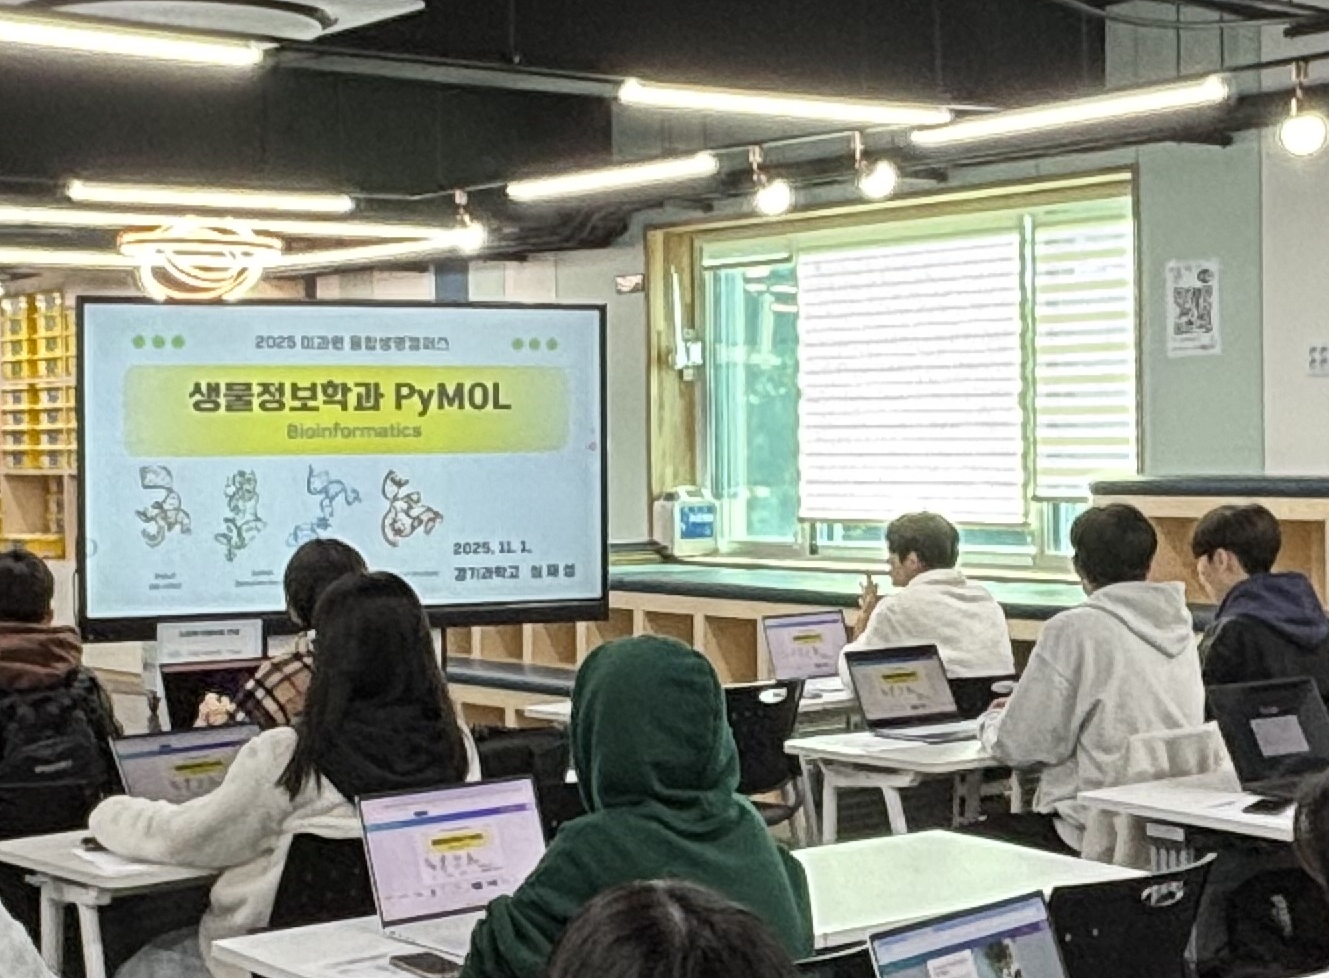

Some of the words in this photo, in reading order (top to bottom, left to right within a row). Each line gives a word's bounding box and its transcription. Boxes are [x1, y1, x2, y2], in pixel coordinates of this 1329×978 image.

[255, 335, 296, 349] 2025
[188, 380, 383, 412] 생물정보학과
[394, 382, 513, 417] PyMOL
[286, 422, 422, 440] Bioinformatics
